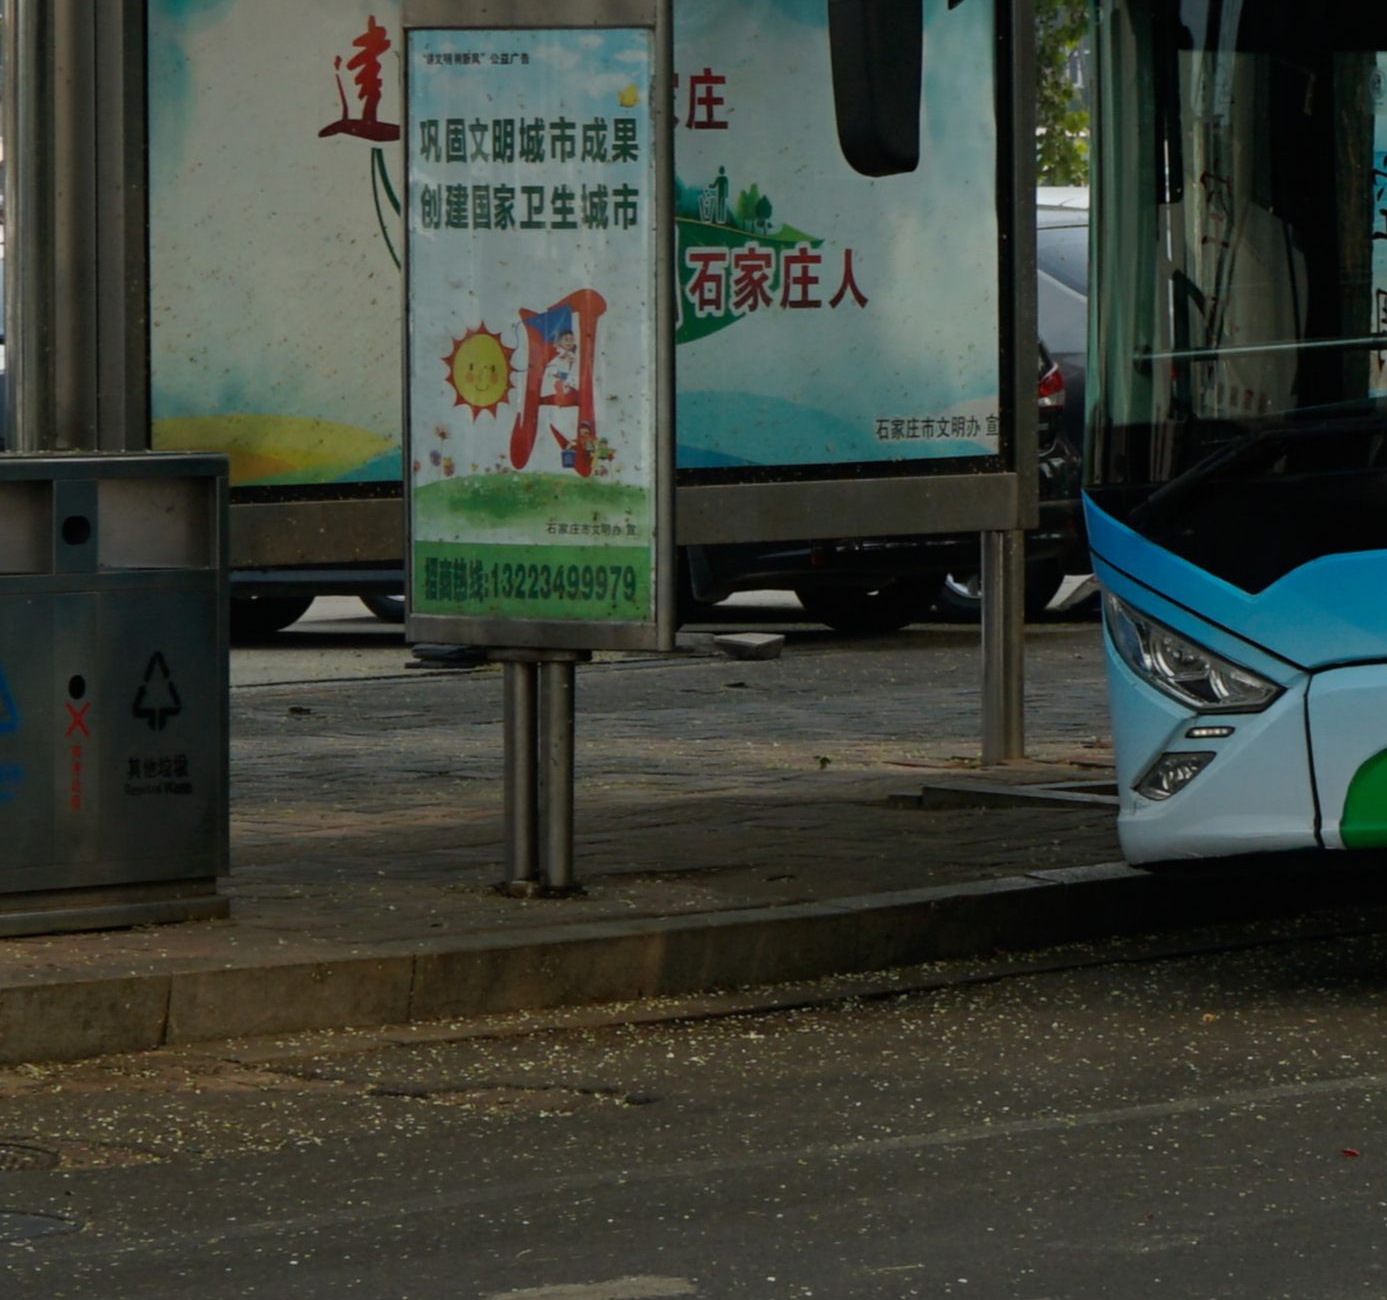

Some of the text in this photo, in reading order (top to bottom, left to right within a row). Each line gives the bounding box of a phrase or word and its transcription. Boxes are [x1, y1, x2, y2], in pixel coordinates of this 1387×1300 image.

[419, 116, 640, 164] 巩固文明城市成果
[419, 183, 640, 231] 创建国家卫生城市
[686, 247, 869, 313] 石家庄人
[875, 415, 982, 441] 石家庄市文明办
